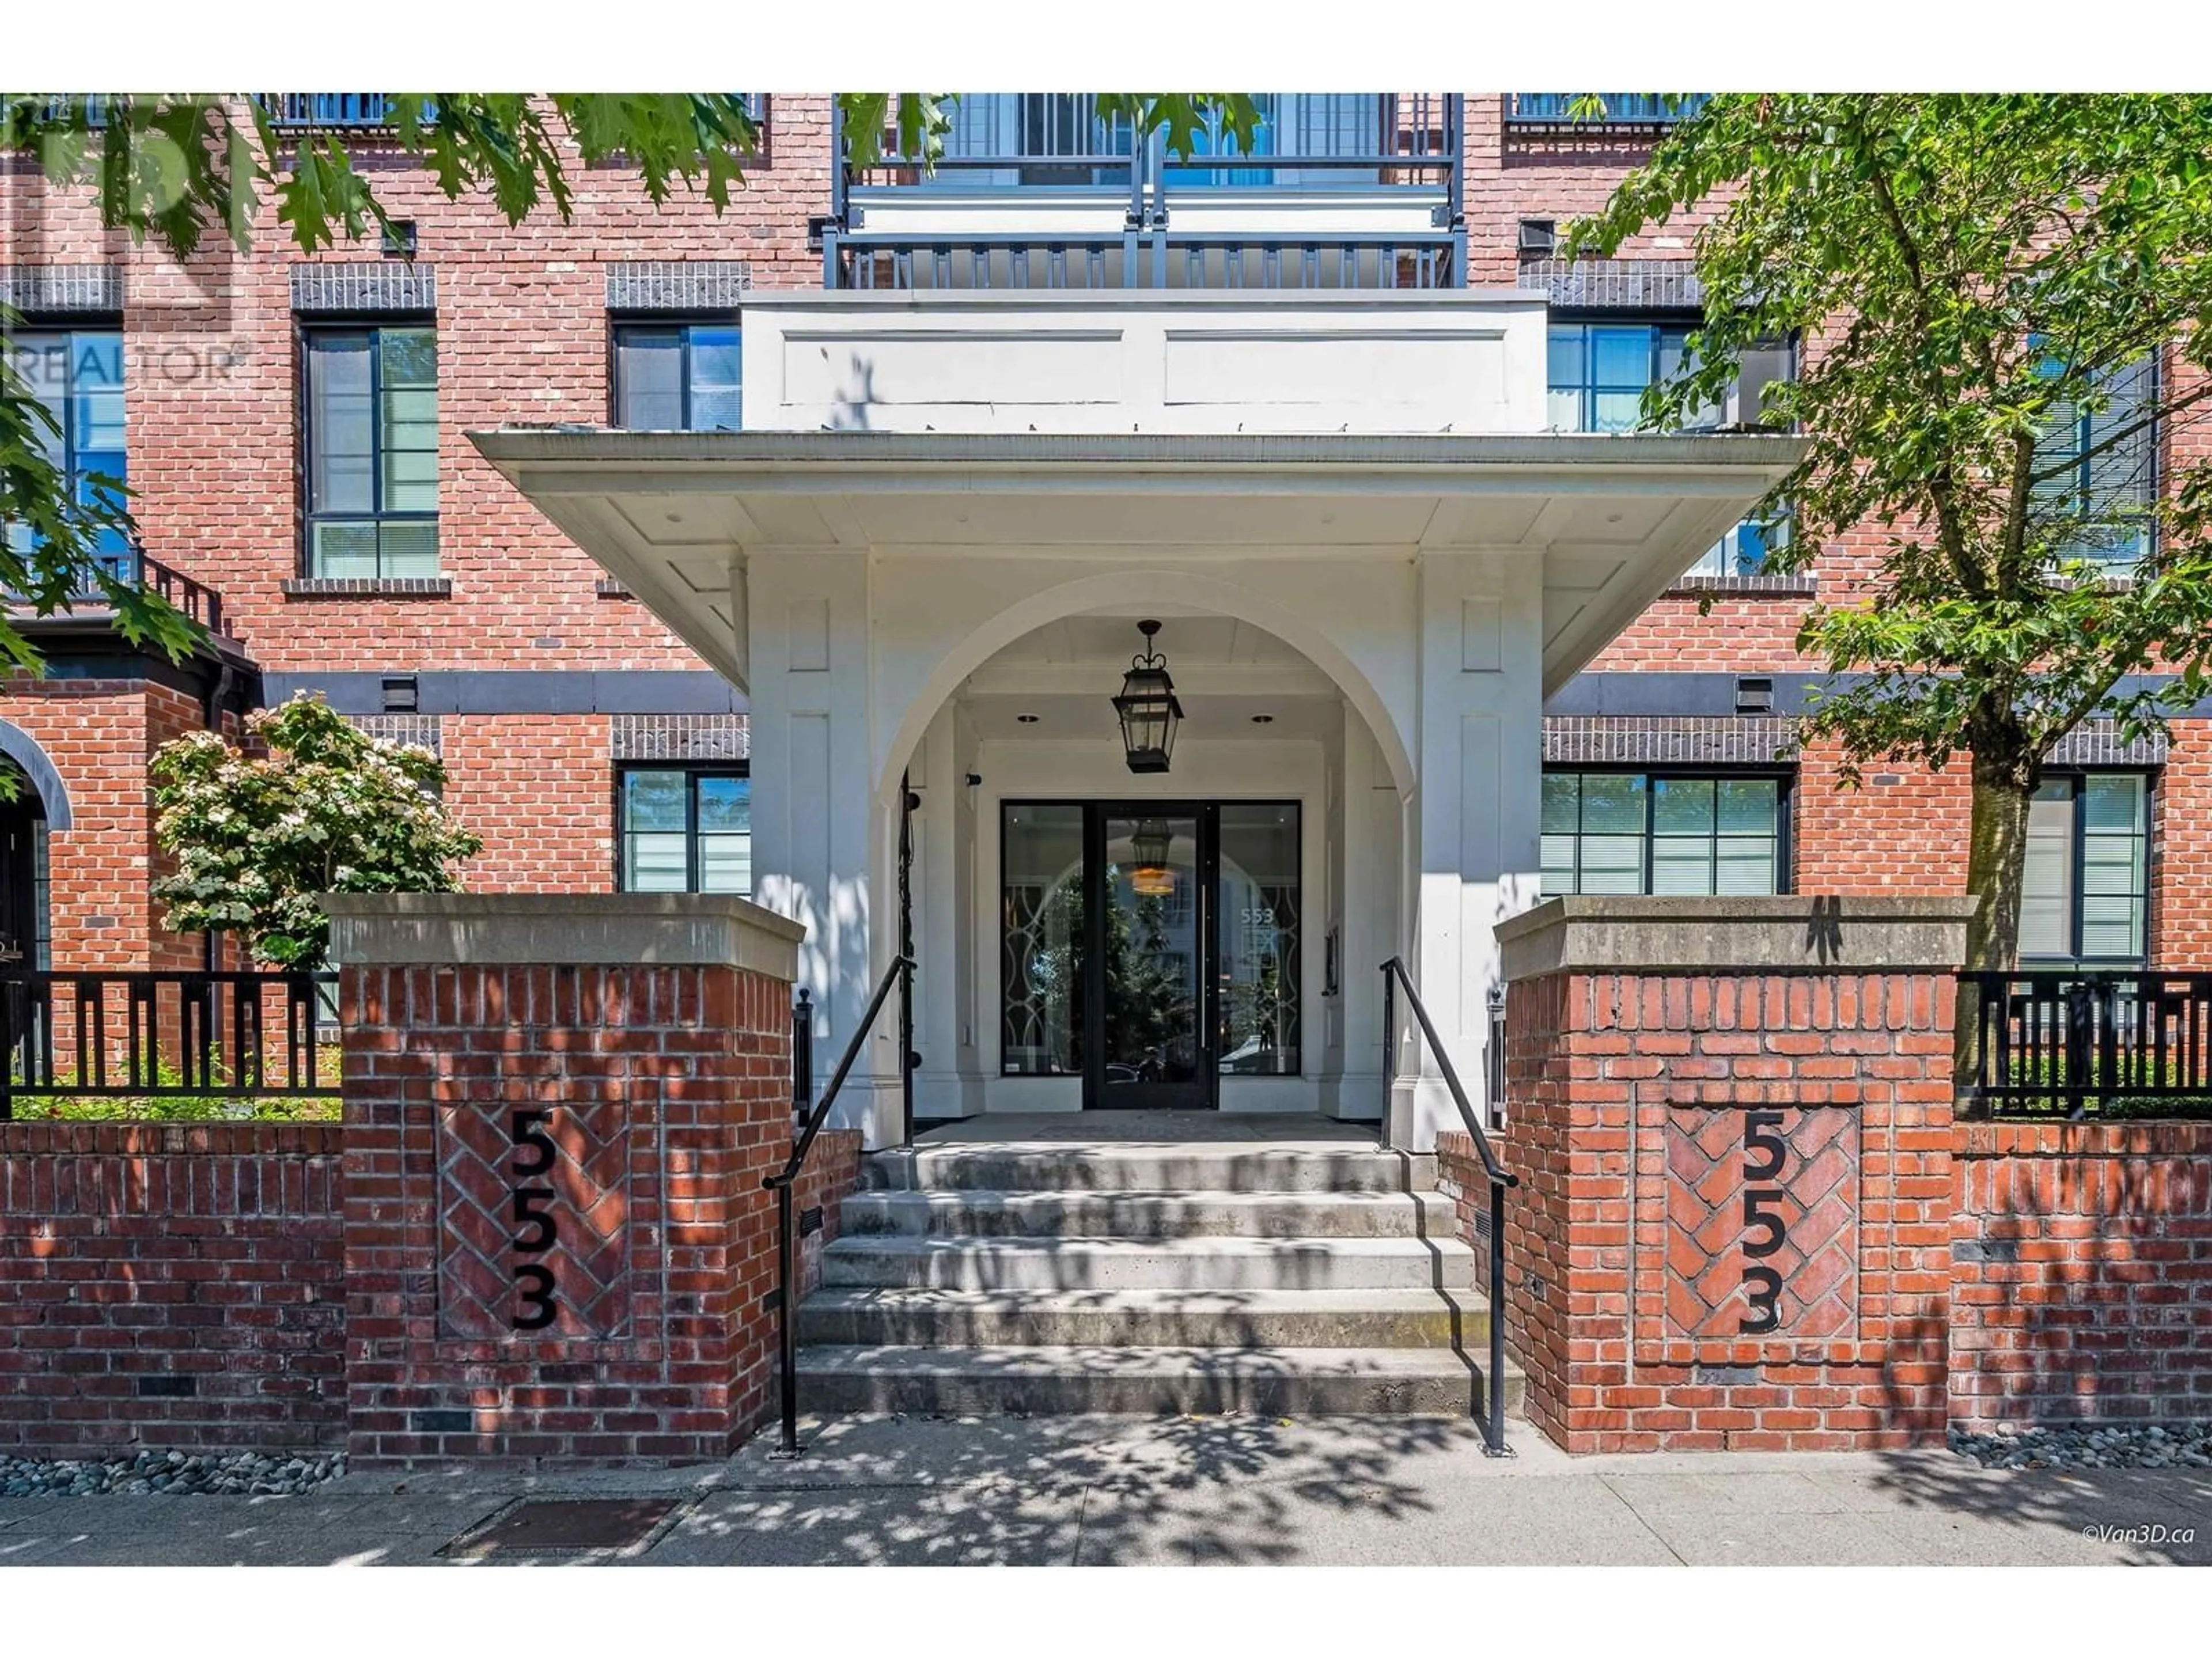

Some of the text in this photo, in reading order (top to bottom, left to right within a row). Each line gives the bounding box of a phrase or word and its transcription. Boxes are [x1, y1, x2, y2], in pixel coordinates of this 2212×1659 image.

[1241, 908, 1274, 923] 553
[511, 1111, 557, 1330] 553
[1739, 1112, 1786, 1334] 553
